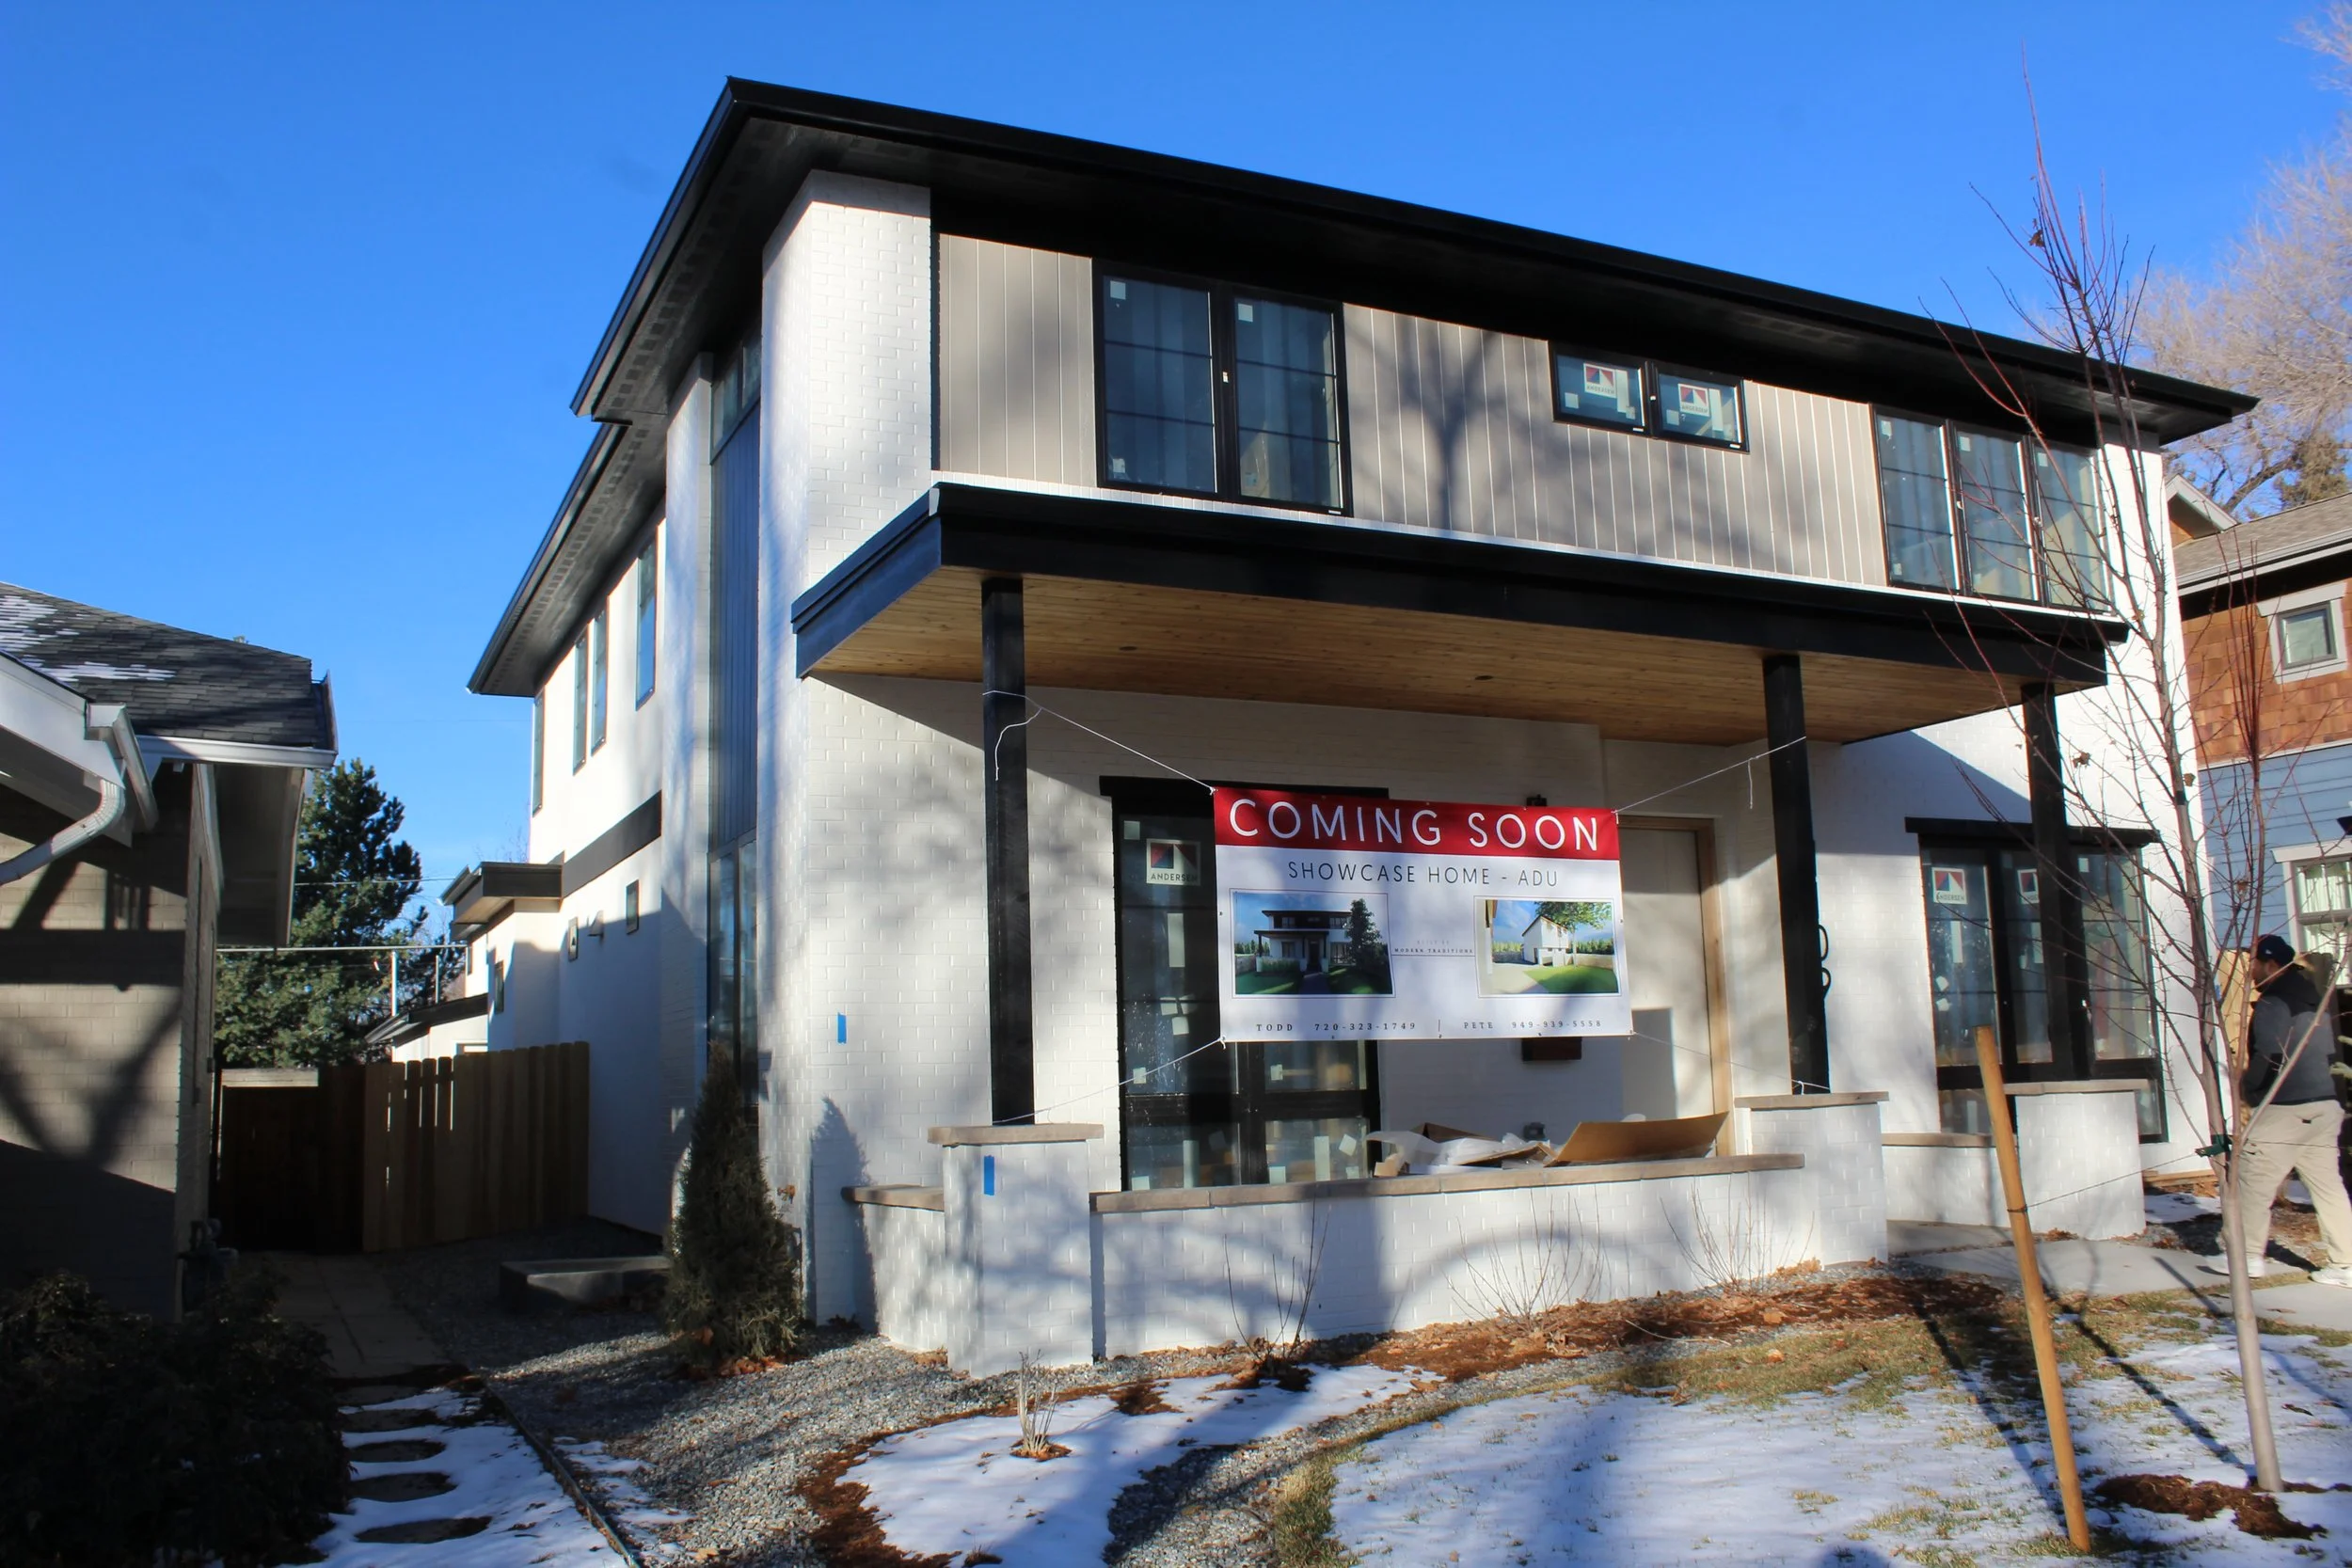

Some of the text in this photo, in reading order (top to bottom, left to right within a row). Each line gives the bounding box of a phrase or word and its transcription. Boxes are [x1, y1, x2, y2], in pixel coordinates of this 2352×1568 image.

[1229, 799, 1597, 851] COMING SOON
[1151, 873, 1199, 881] ANDERSEN
[1288, 861, 1415, 882] SHOWCASE
[1428, 866, 1489, 885] HOME
[1518, 870, 1557, 887] ADU
[1256, 1022, 1416, 1032] TODD 720-323-1749
[1463, 1020, 1601, 1029] PETE 949-939-5558
